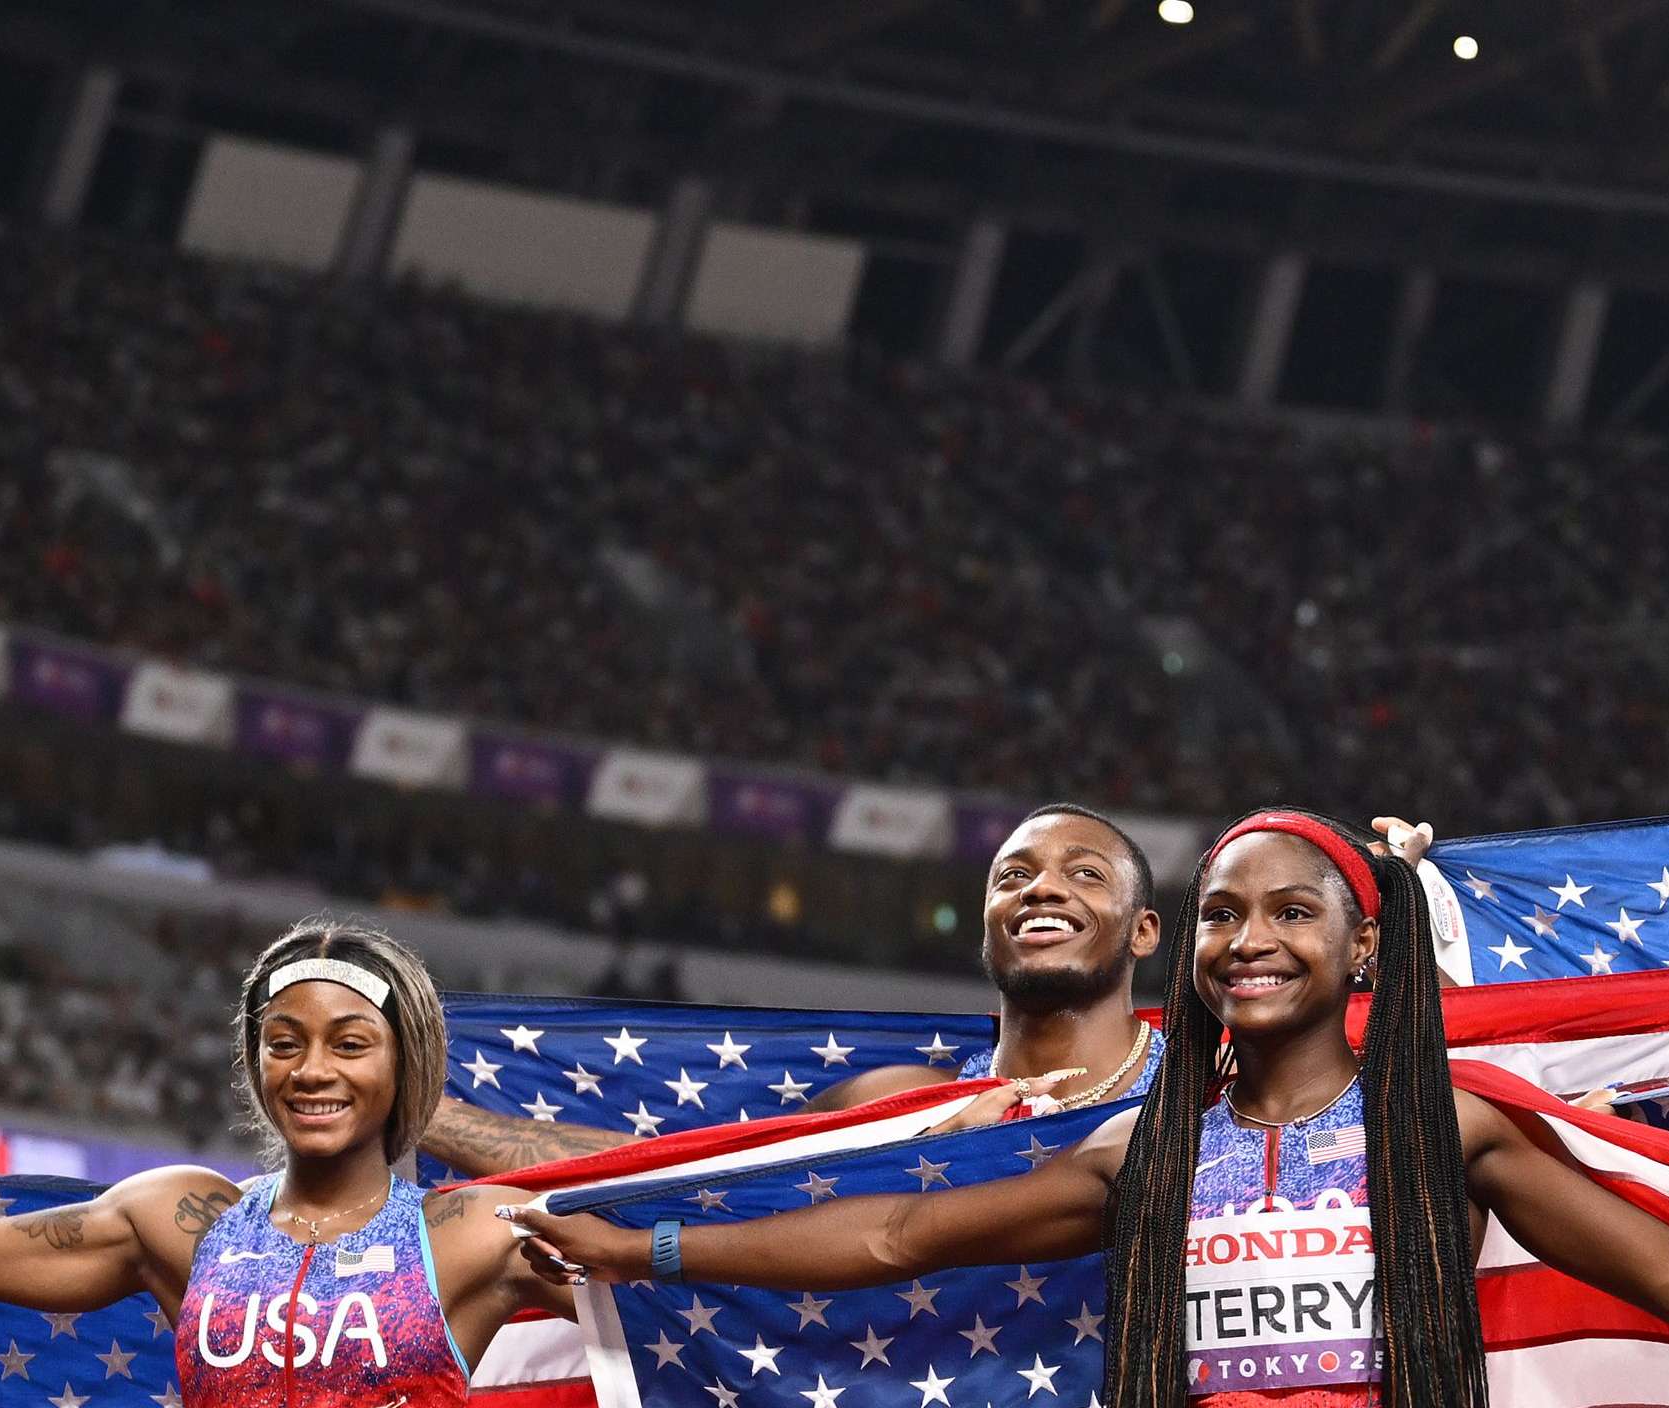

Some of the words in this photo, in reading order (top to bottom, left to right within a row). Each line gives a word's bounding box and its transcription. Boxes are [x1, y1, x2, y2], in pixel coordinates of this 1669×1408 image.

[1186, 1225, 1373, 1266] HONDA
[198, 1292, 387, 1368] USA
[1186, 1279, 1374, 1341] TERRY
